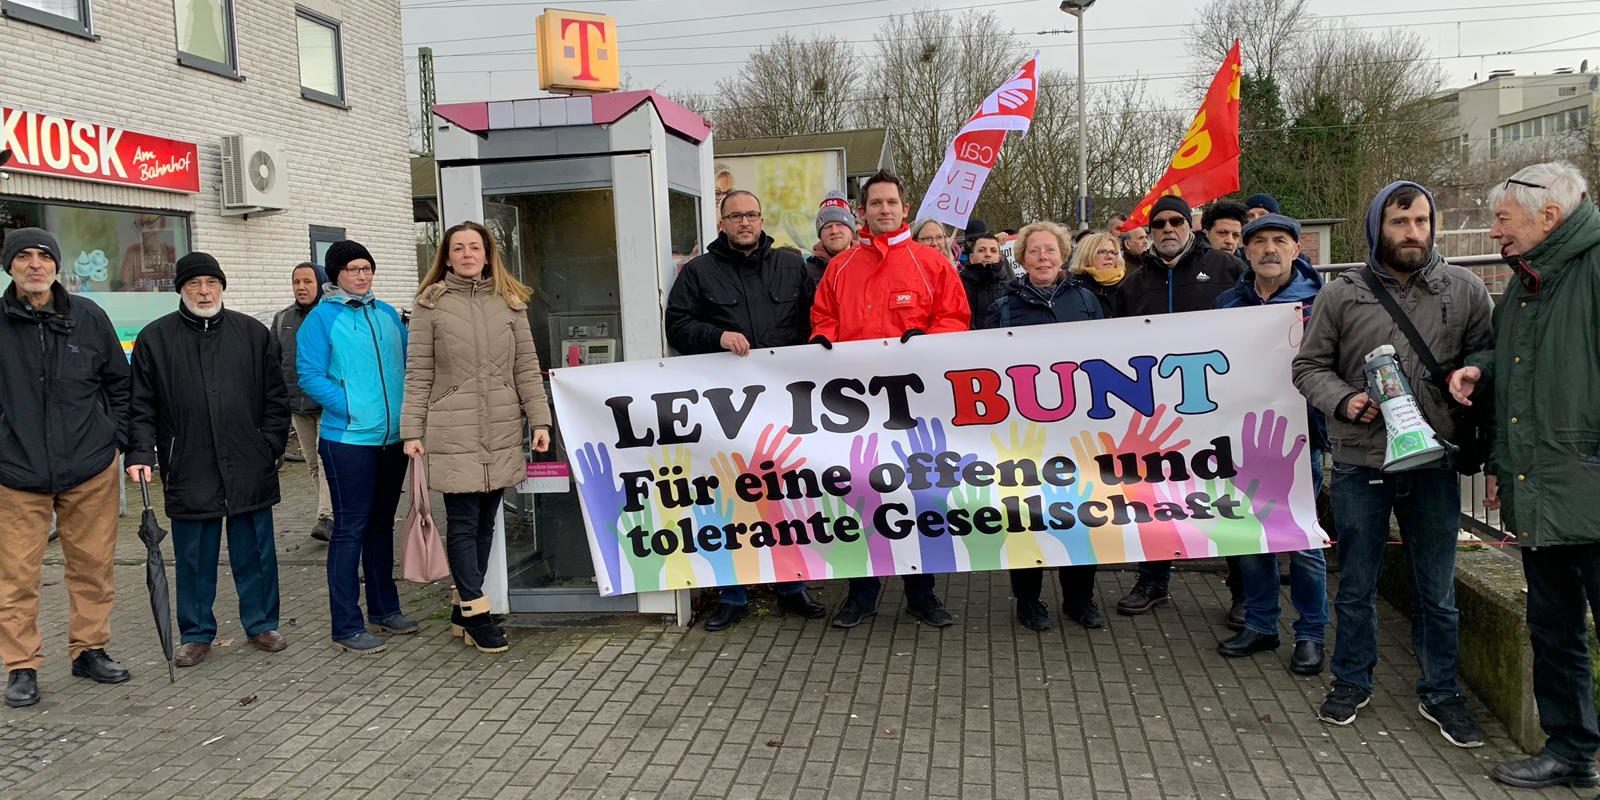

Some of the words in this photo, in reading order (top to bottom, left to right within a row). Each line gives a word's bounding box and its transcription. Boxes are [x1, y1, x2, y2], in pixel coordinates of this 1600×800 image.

[561, 18, 606, 81] T
[0, 107, 128, 178] KIOSK
[132, 145, 156, 165] Am
[138, 151, 192, 181] Bahnhof
[605, 384, 766, 449] LEV
[786, 373, 925, 434] IST
[944, 349, 1230, 426] BUNT
[619, 465, 719, 513] Für
[735, 460, 851, 503] eine
[869, 451, 1077, 493] offene
[1094, 436, 1237, 486] und
[627, 511, 860, 558] tolerante
[873, 491, 1246, 540] Gesellschaft
